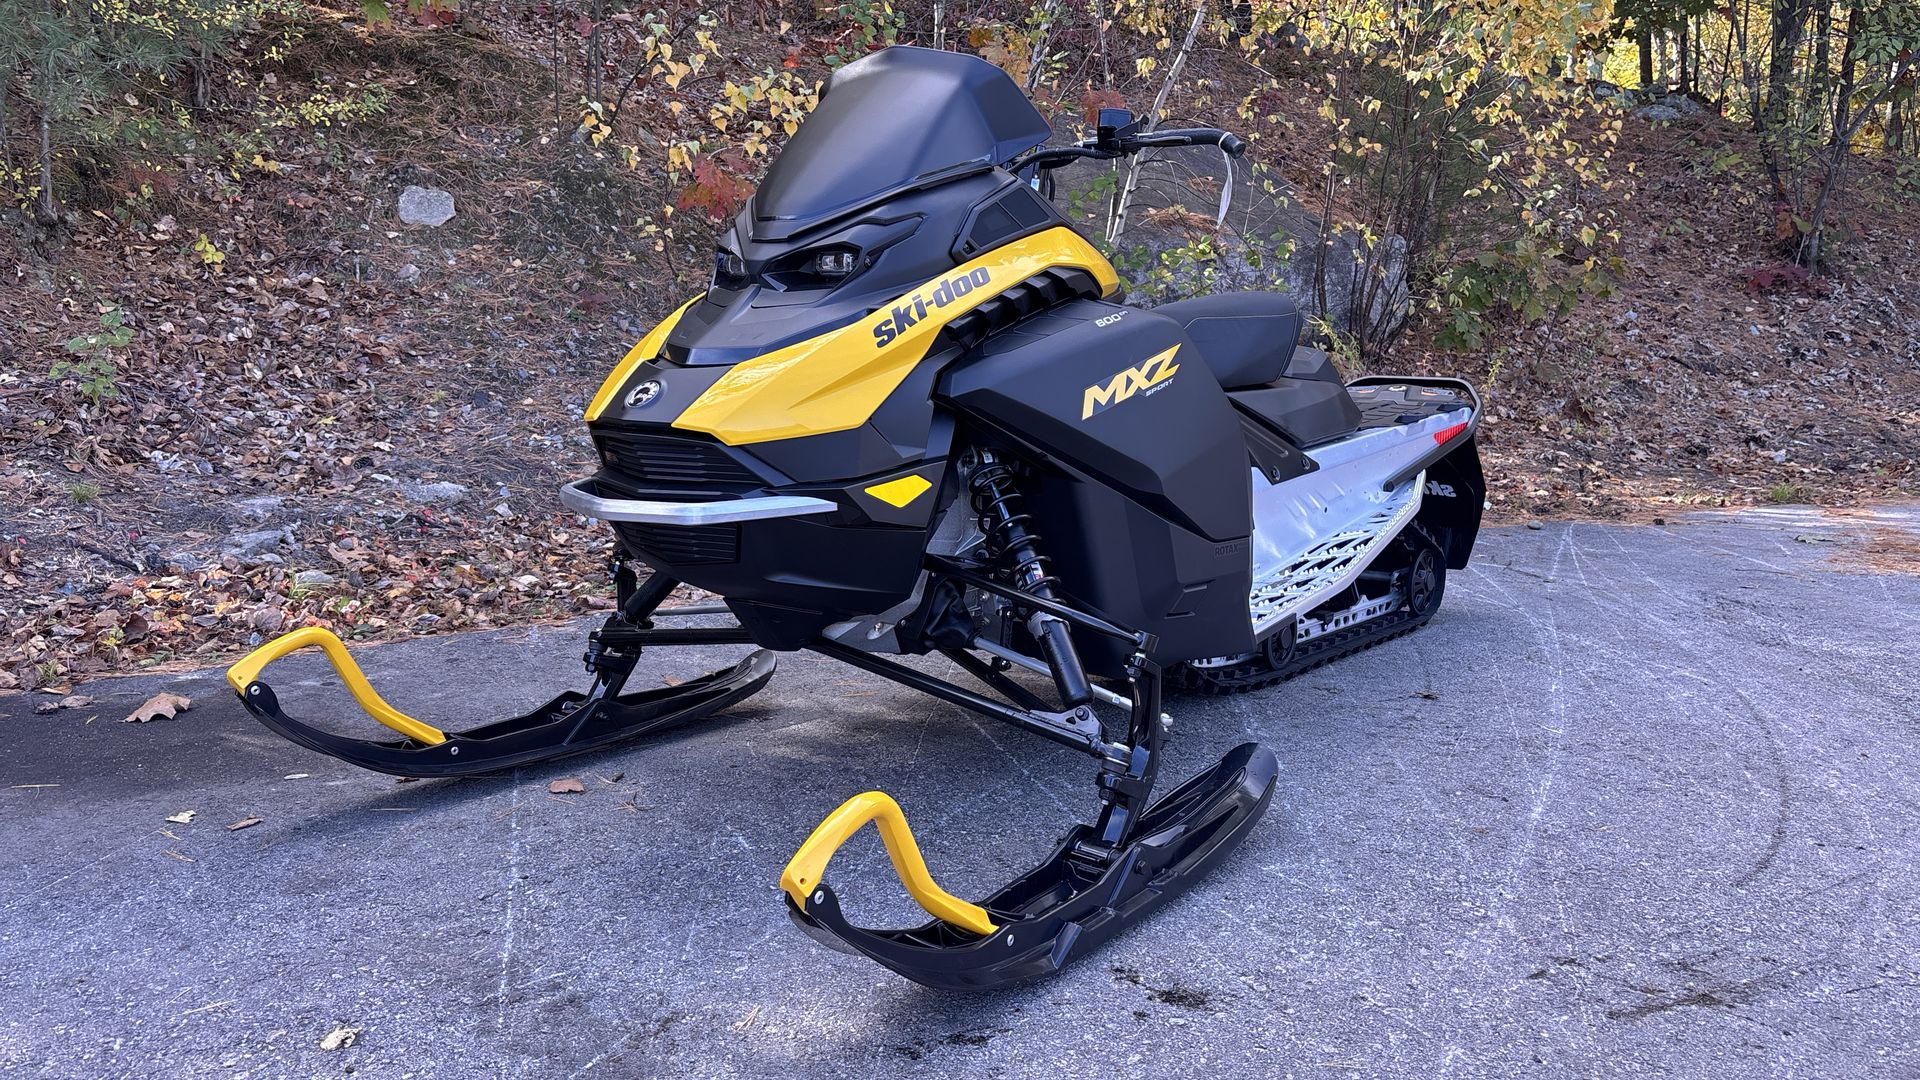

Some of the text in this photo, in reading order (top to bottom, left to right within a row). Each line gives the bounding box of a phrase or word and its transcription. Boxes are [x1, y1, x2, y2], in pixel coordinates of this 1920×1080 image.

[872, 266, 991, 348] ski-doo
[1095, 313, 1122, 328] 600
[1082, 342, 1182, 420] MXZ
[1145, 378, 1174, 397] SPORT
[1214, 543, 1239, 556] ROTAX
